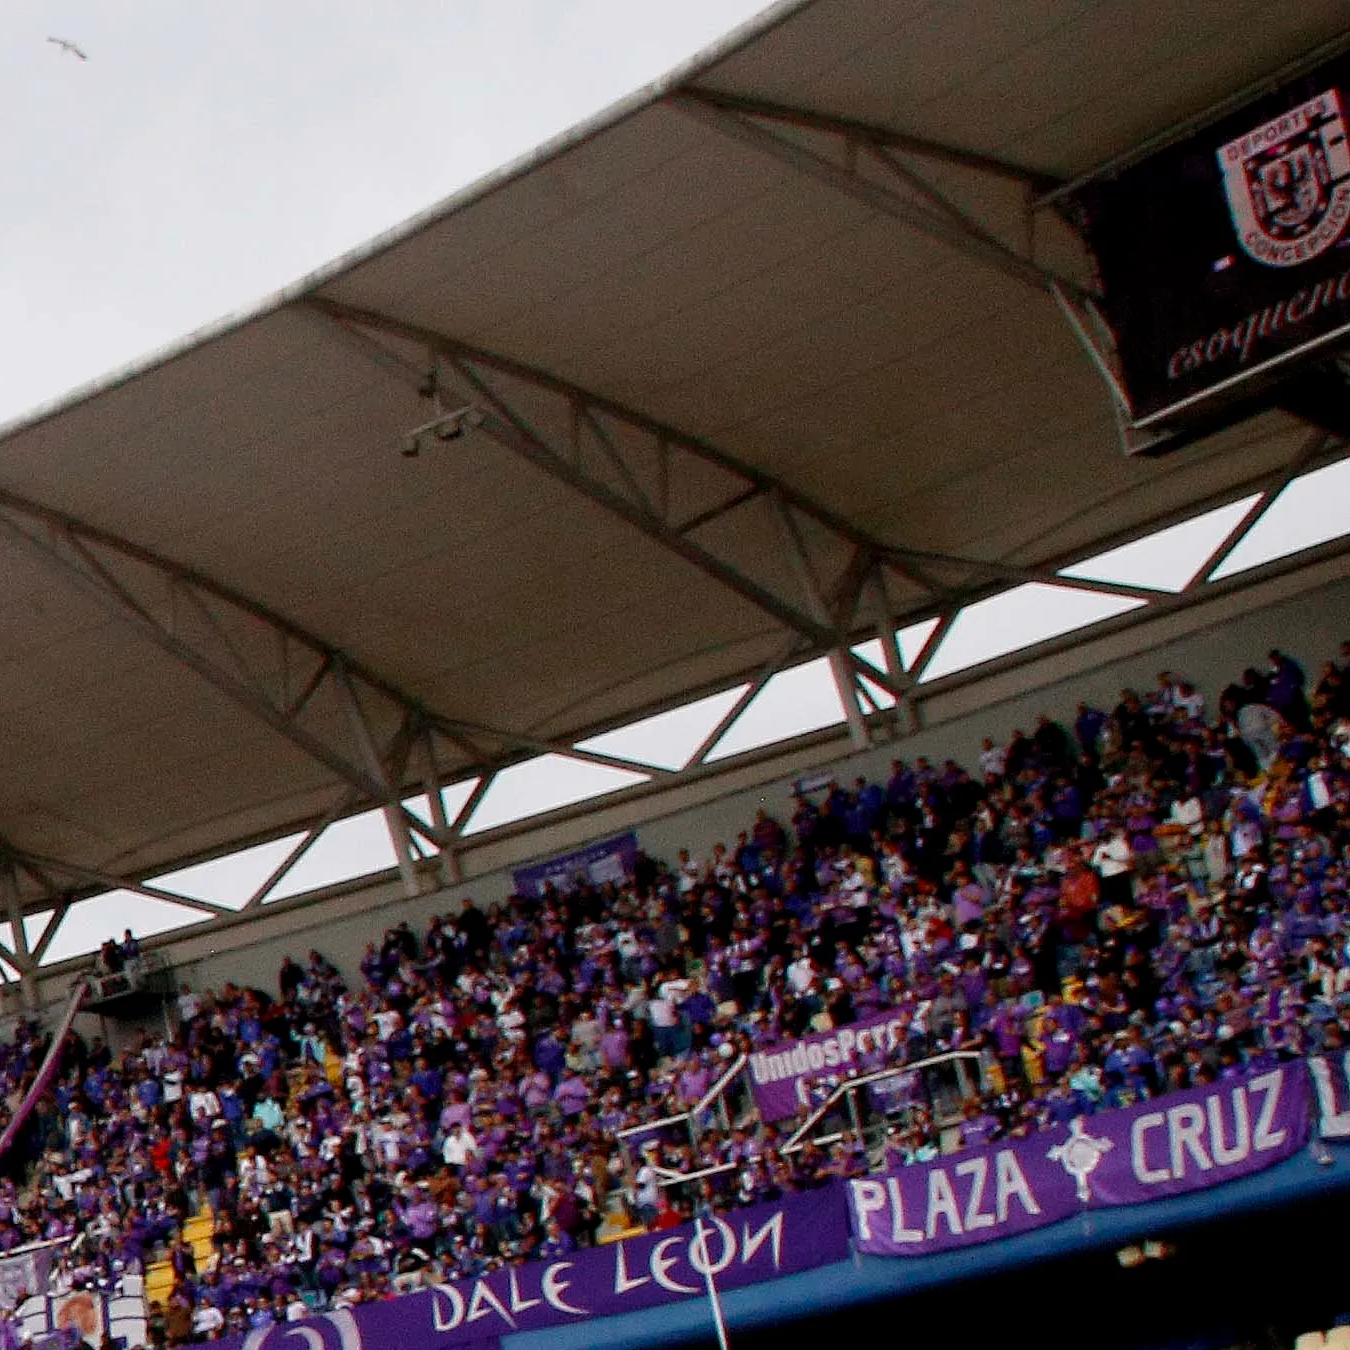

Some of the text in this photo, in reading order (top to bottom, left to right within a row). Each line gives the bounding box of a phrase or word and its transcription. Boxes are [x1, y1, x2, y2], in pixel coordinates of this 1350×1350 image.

[849, 1069, 1285, 1244] PLAZA CRUZ
[431, 1260, 592, 1333] DALE
